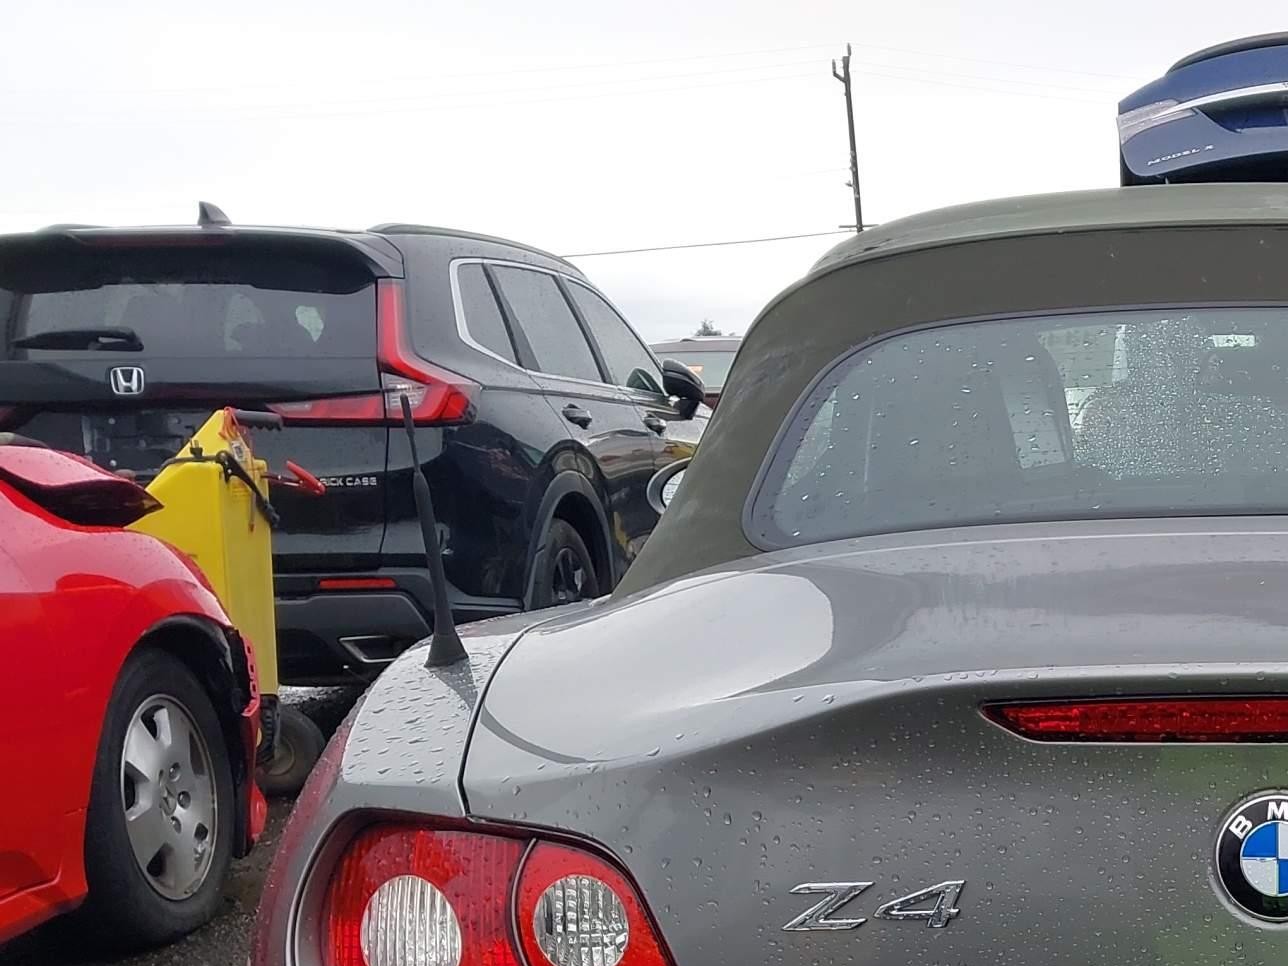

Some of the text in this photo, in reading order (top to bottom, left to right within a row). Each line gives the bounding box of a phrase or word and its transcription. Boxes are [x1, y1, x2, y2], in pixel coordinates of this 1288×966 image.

[1147, 148, 1200, 166] MODEL
[345, 476, 377, 487] CASE
[781, 879, 967, 932] Z4
